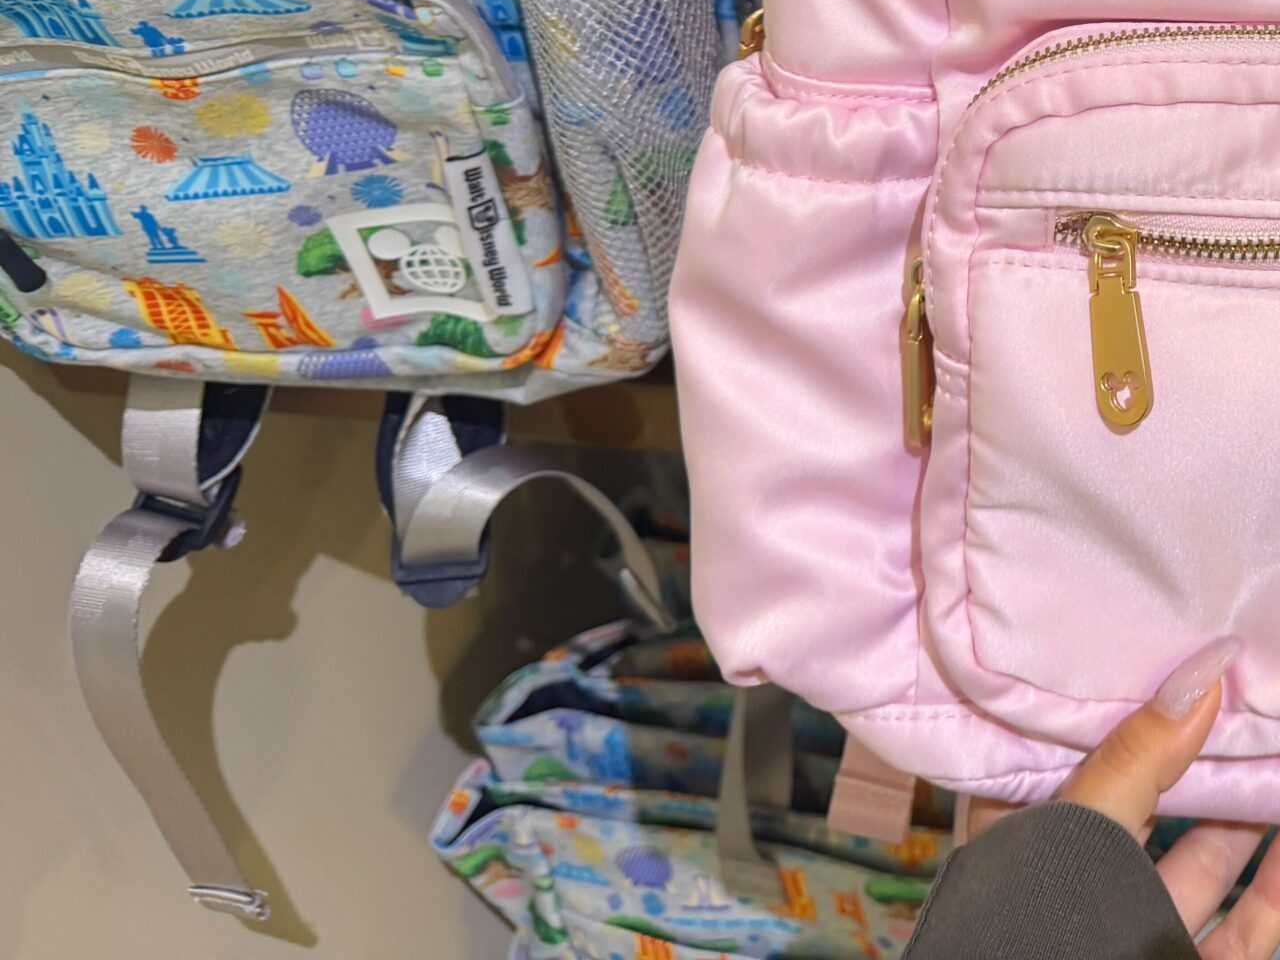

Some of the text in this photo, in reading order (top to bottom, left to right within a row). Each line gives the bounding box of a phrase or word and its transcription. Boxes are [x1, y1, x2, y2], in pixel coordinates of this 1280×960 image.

[463, 165, 513, 307] Walt Disney World
